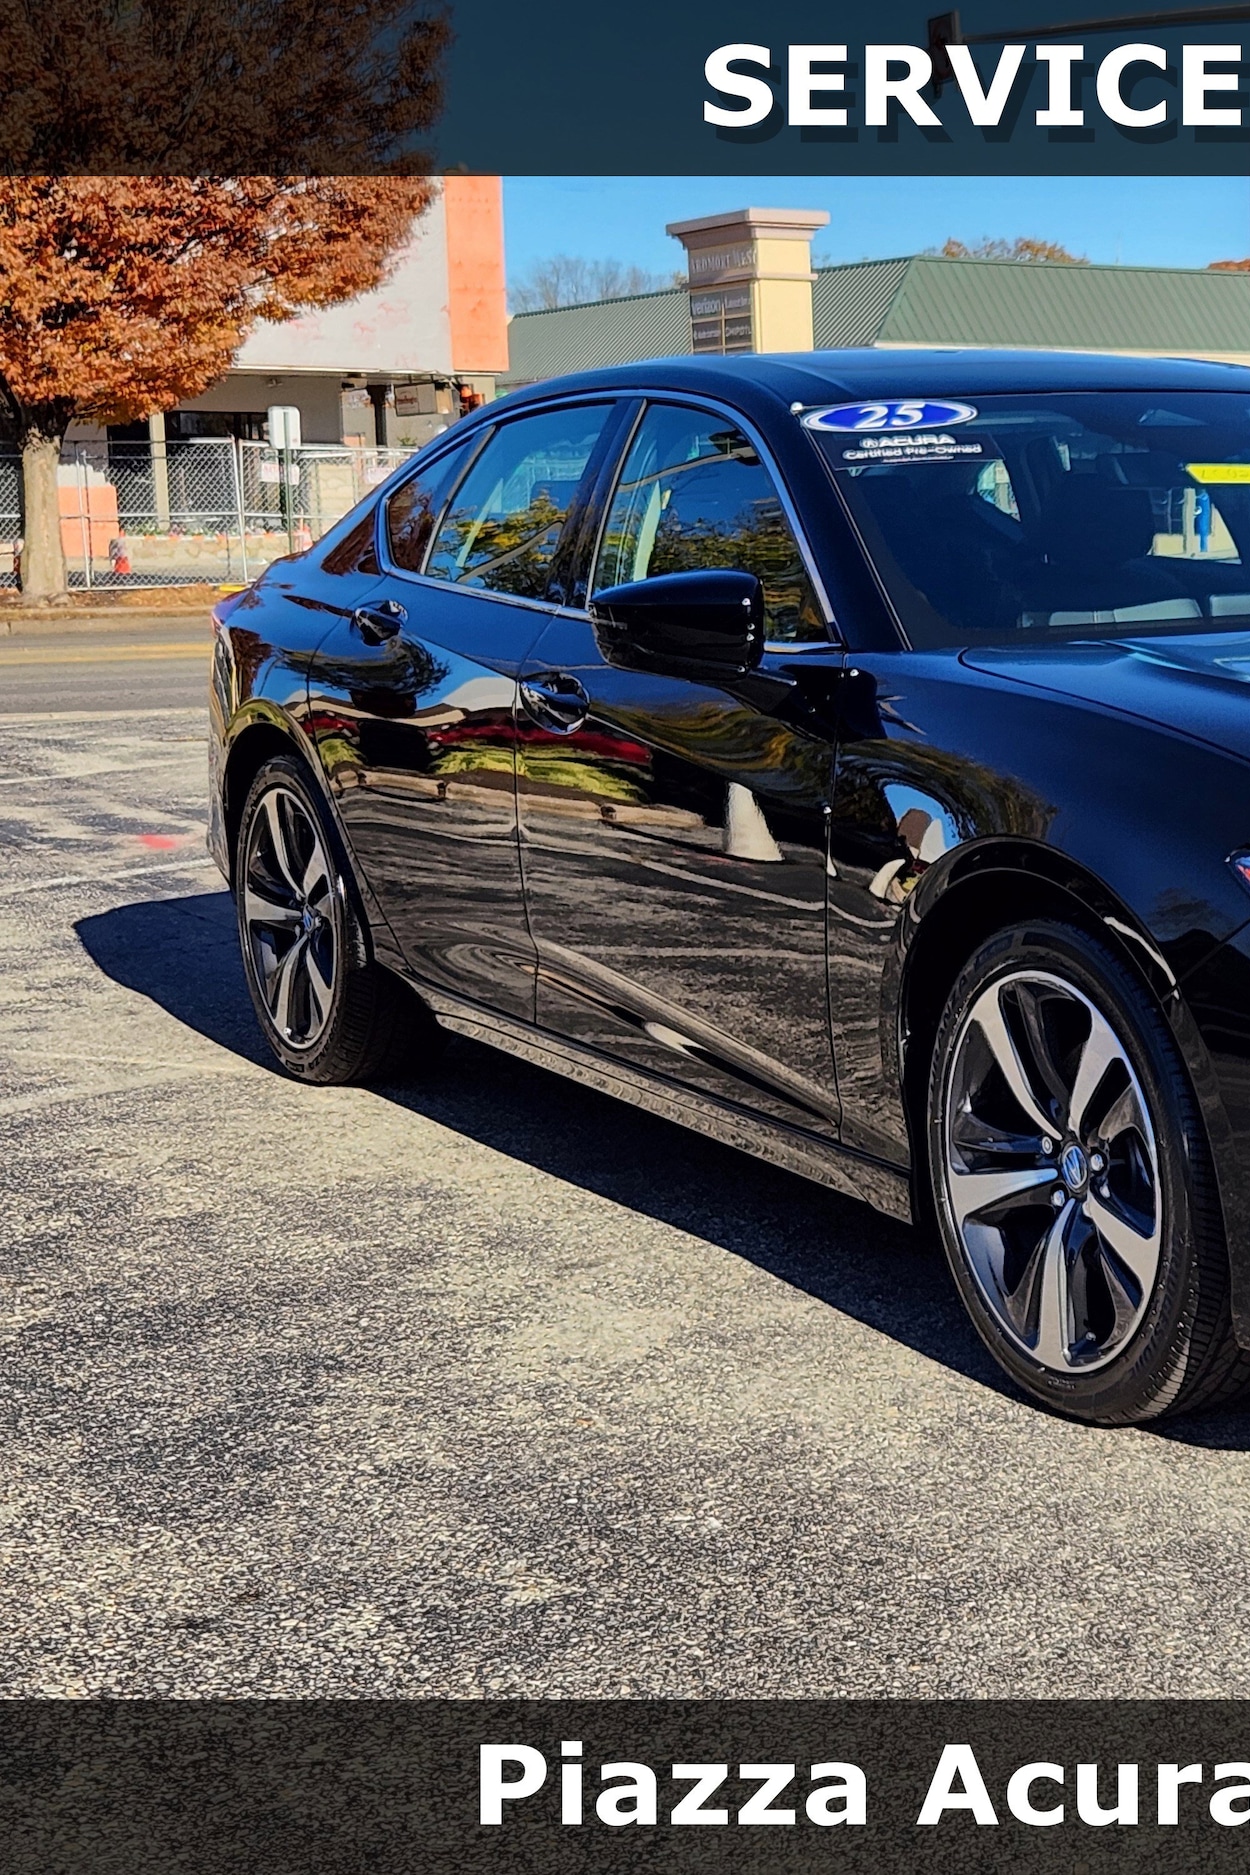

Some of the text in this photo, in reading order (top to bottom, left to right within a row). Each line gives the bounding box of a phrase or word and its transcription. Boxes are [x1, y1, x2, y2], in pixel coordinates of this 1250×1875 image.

[855, 402, 926, 428] 25
[879, 434, 956, 446] ACURA
[843, 444, 982, 459] Certified Pre-Owned
